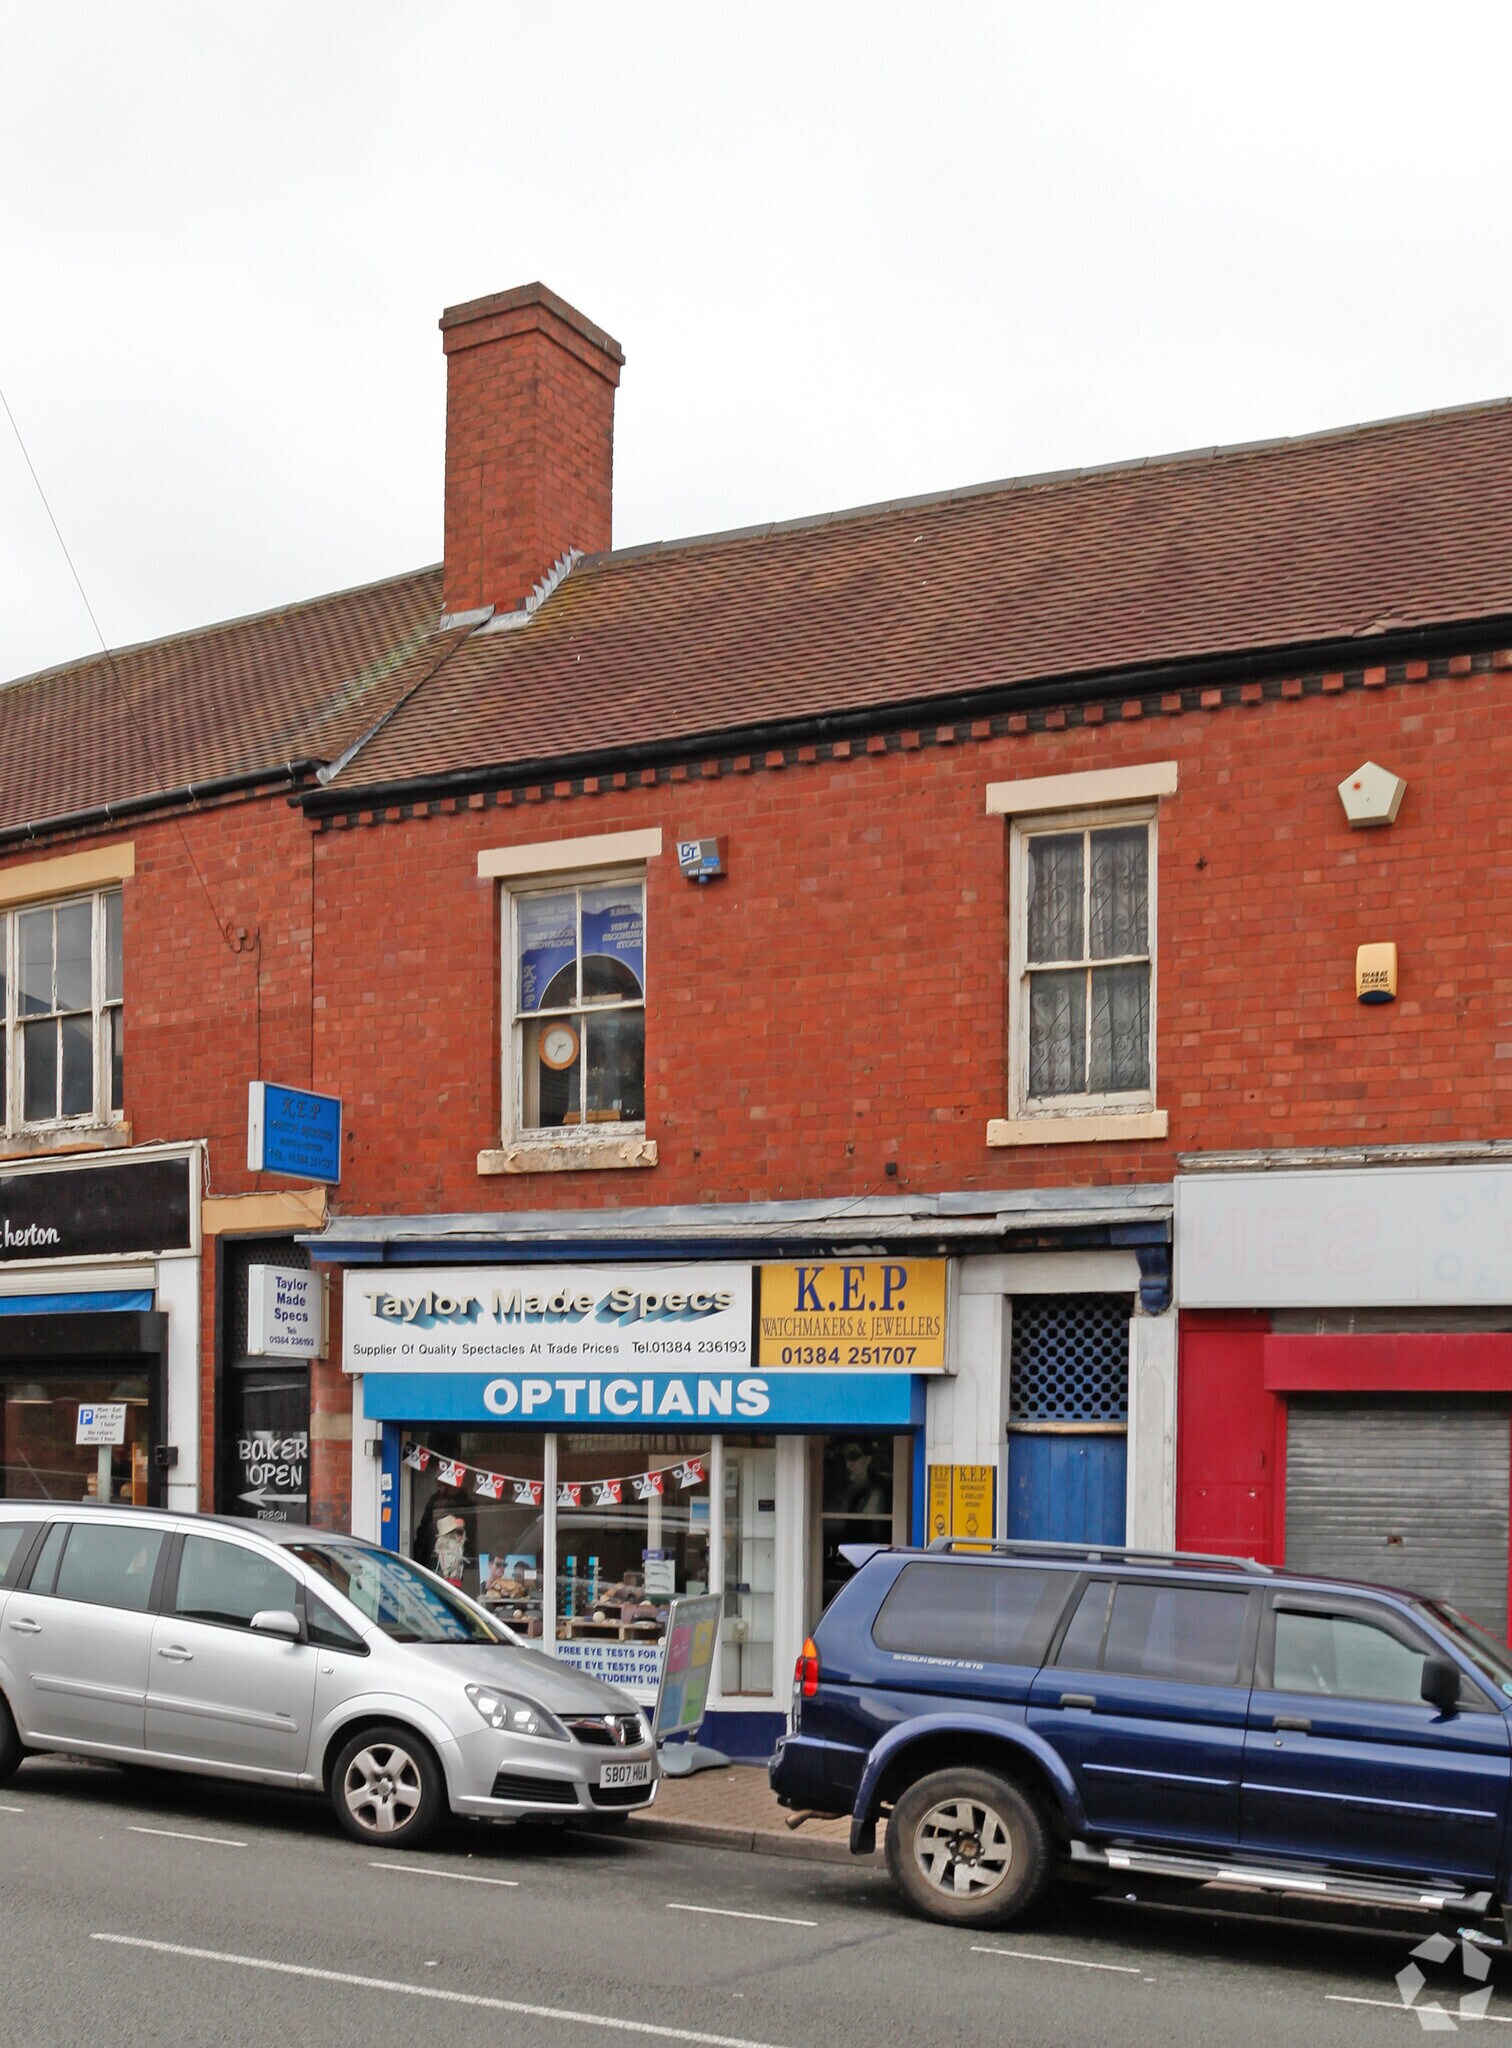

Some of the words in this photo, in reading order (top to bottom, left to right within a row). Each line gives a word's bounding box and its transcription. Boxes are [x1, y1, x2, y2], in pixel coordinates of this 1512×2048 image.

[275, 1276, 308, 1292] Taylor
[794, 1265, 908, 1312] K.E.P.
[276, 1292, 306, 1306] Made
[363, 1289, 479, 1325] Taylor
[491, 1288, 595, 1319] Made
[606, 1285, 737, 1321] Specs
[274, 1307, 309, 1323] Specs
[762, 1317, 854, 1337] WATCHMAKERS
[857, 1319, 867, 1337] &
[869, 1316, 941, 1341] JEWELLERS
[353, 1343, 397, 1356] Supplier
[401, 1343, 415, 1355] Of
[418, 1343, 458, 1356] Quality
[462, 1343, 526, 1356] Spectacles
[529, 1342, 542, 1354] At
[547, 1342, 578, 1355] Trade
[582, 1342, 620, 1354] Prices
[697, 1340, 747, 1353] 236193
[781, 1347, 841, 1365] 01384
[848, 1346, 917, 1365] 251707
[483, 1379, 770, 1417] OPTICIANS
[558, 1645, 582, 1655] FREE
[584, 1647, 603, 1657] EYE
[606, 1648, 635, 1658] TESTS
[638, 1650, 657, 1660] FOR
[560, 1660, 582, 1669] REE
[585, 1661, 604, 1671] EYE
[607, 1662, 636, 1672] TESTS
[639, 1664, 658, 1673] FOR
[595, 1673, 644, 1684] STUDENTS
[605, 1766, 632, 1783] SB07
